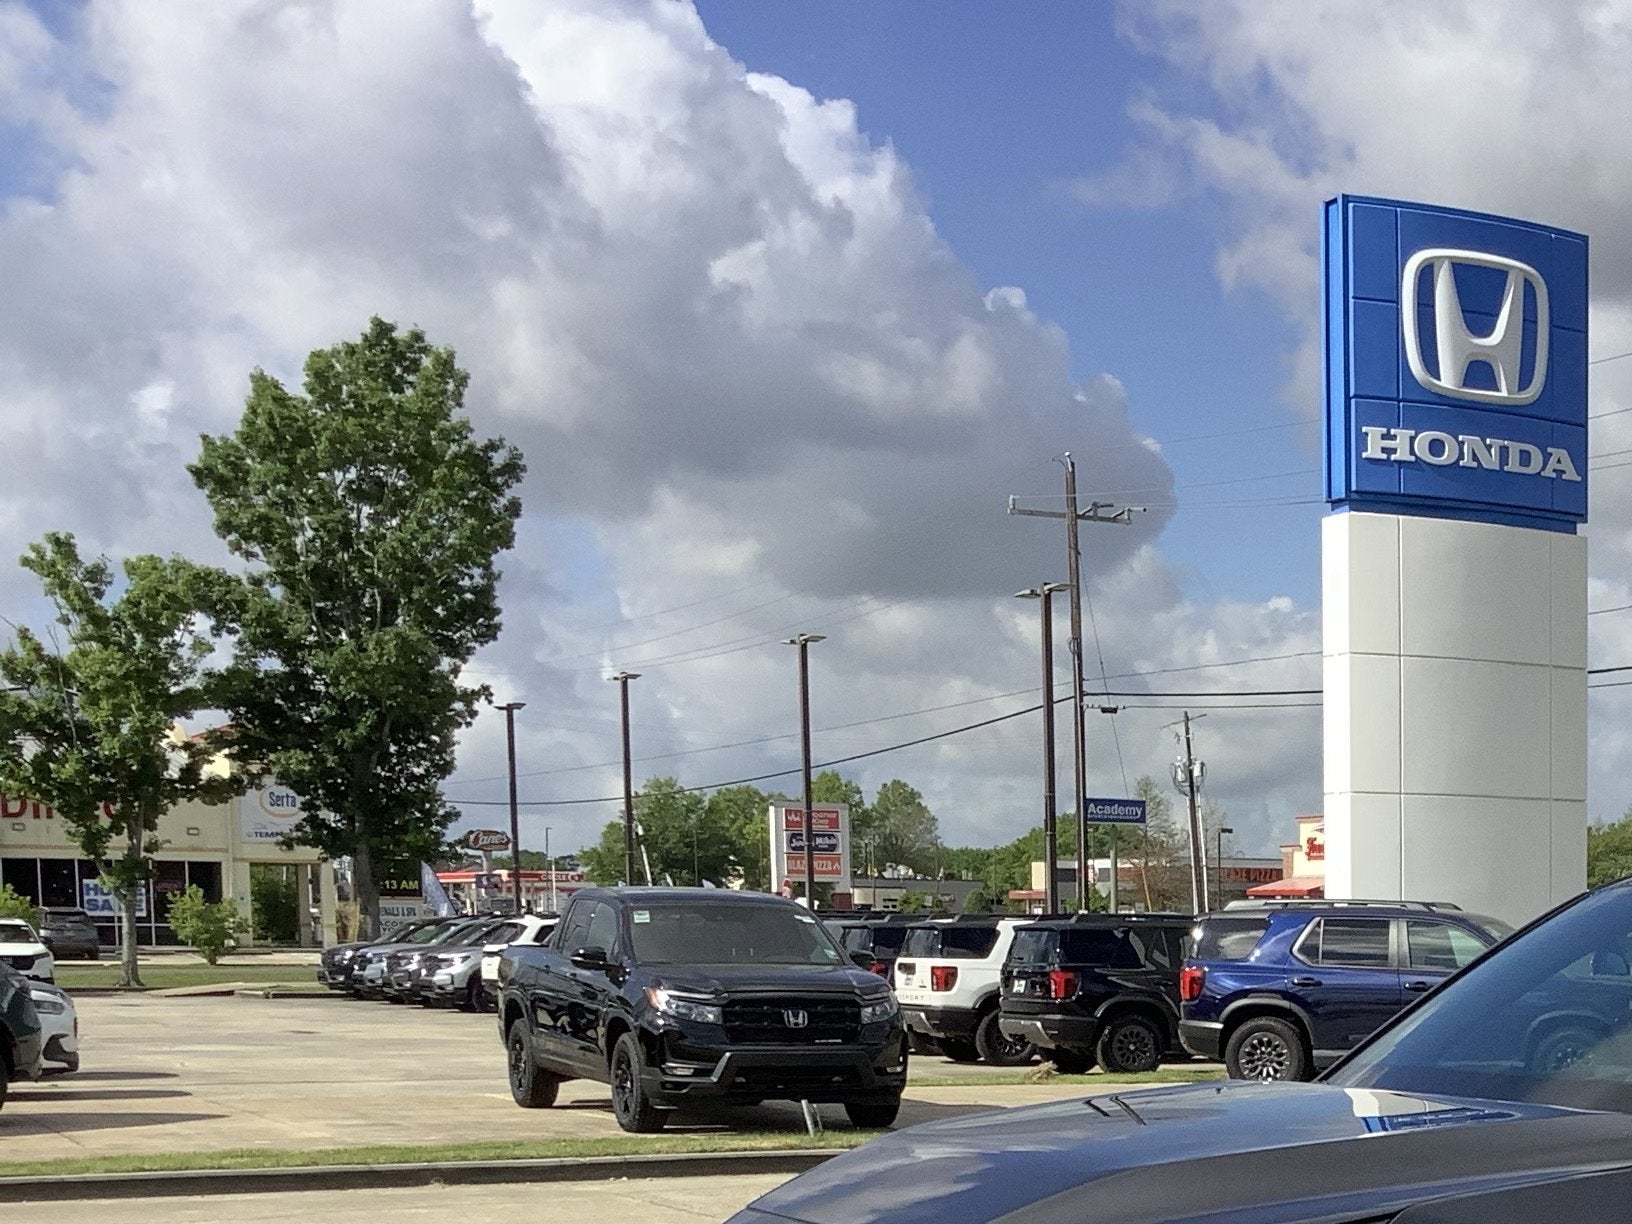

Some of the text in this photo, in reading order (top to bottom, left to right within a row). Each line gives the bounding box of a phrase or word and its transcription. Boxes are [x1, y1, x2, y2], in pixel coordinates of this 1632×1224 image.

[1362, 427, 1582, 482] HONDA
[269, 791, 296, 808] Serta
[1088, 803, 1142, 818] Academy
[400, 881, 418, 889] AM
[86, 899, 144, 911] SAE
